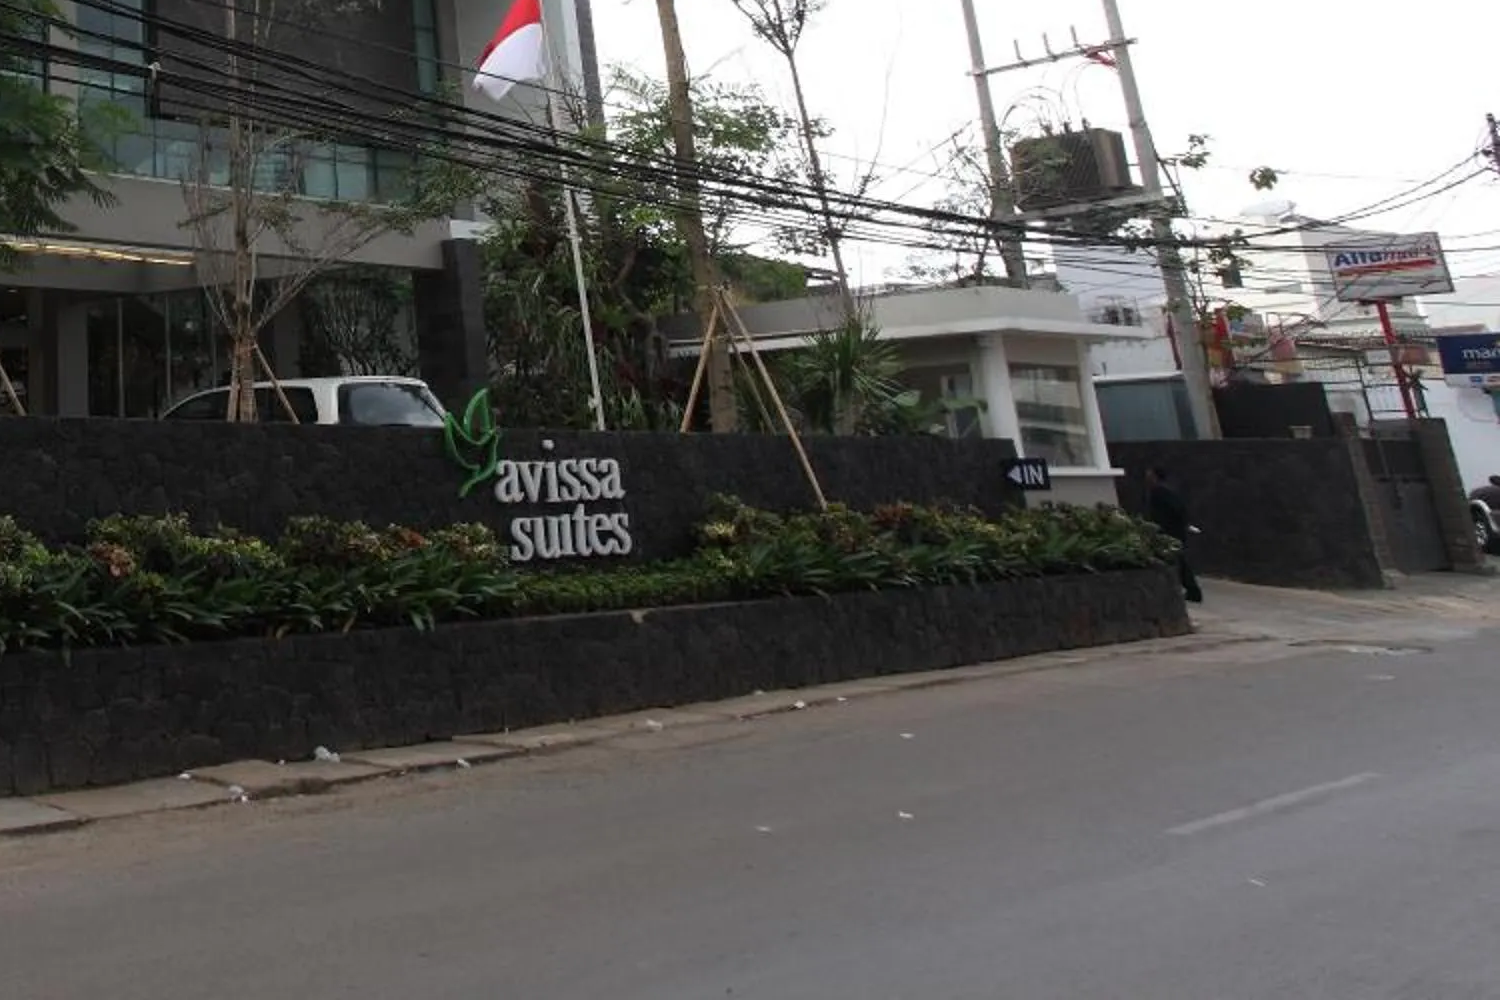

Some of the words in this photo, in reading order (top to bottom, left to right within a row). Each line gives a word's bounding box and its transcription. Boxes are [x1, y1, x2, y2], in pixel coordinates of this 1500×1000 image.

[494, 439, 626, 503] avissa
[1023, 464, 1045, 485] IN
[510, 503, 632, 561] suites
